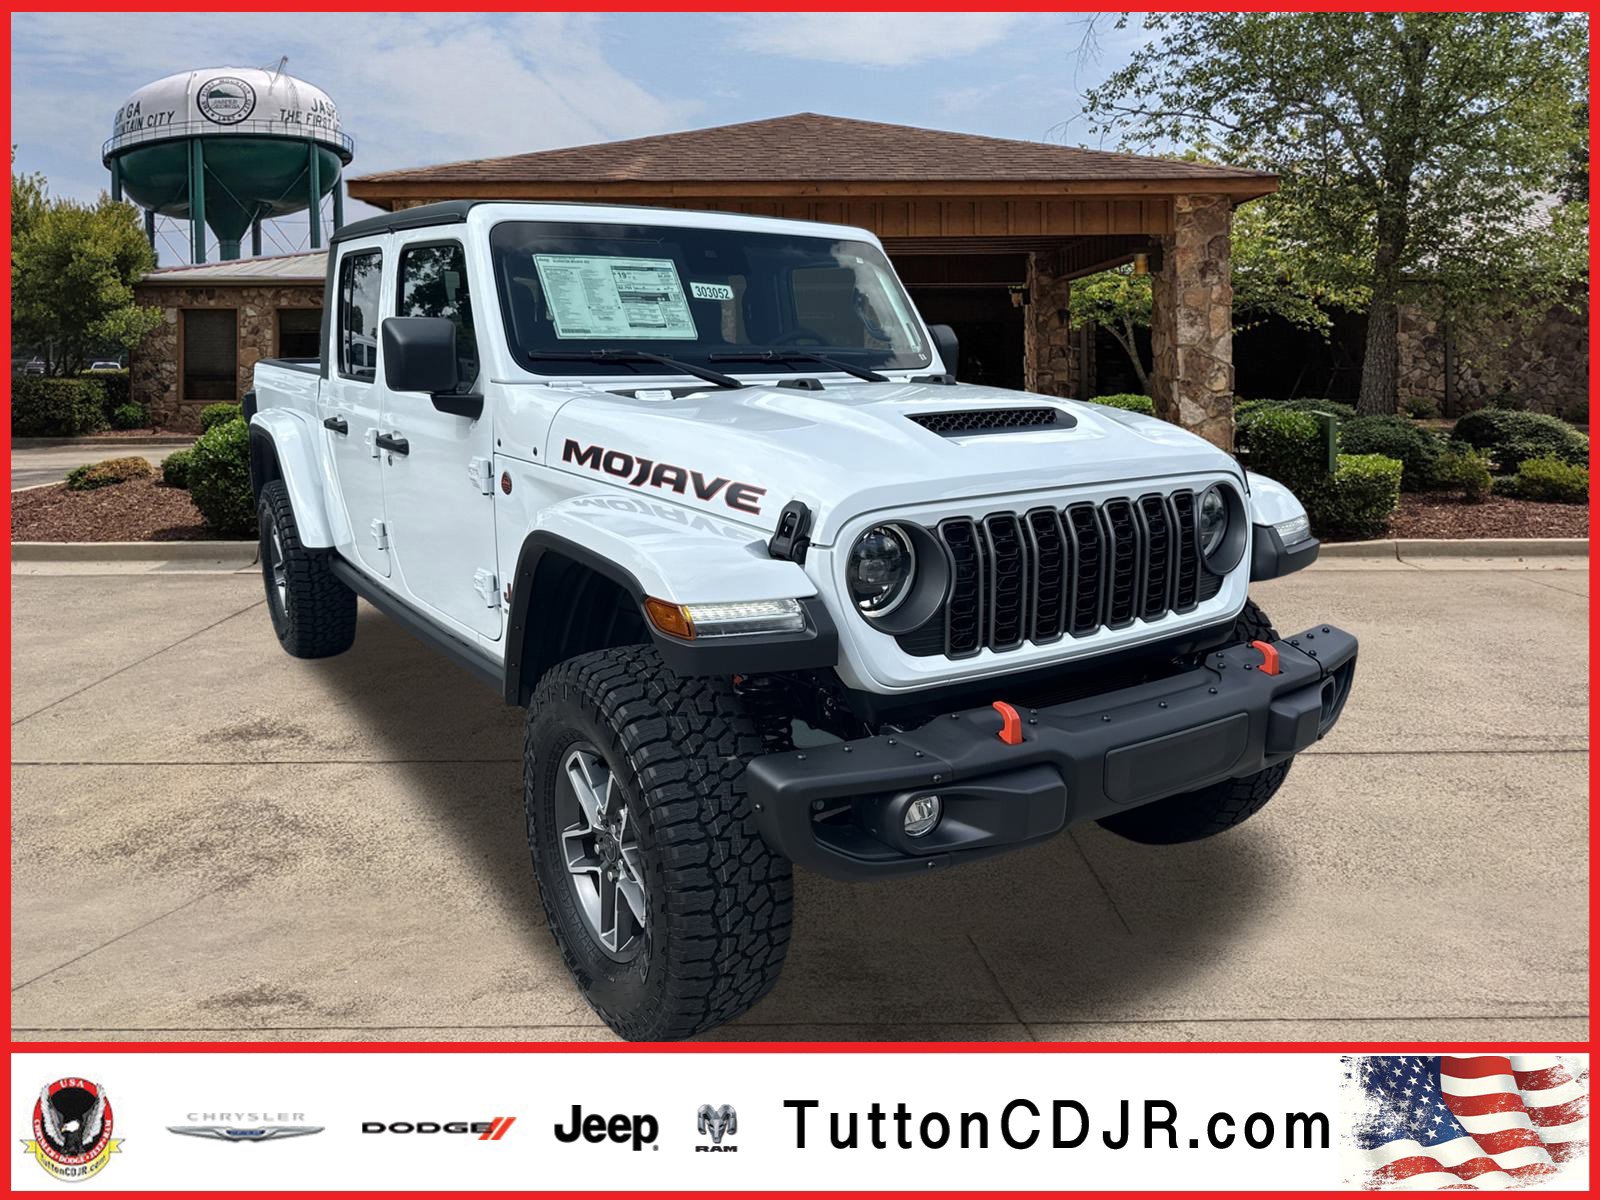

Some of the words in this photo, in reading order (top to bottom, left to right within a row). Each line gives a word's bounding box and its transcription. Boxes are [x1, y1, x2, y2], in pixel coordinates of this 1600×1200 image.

[126, 101, 141, 119] GA
[147, 110, 175, 127] CITY
[280, 109, 302, 124] THE
[306, 112, 331, 129] FIRST
[695, 286, 730, 299] 303052
[562, 438, 767, 515] MOJAVE
